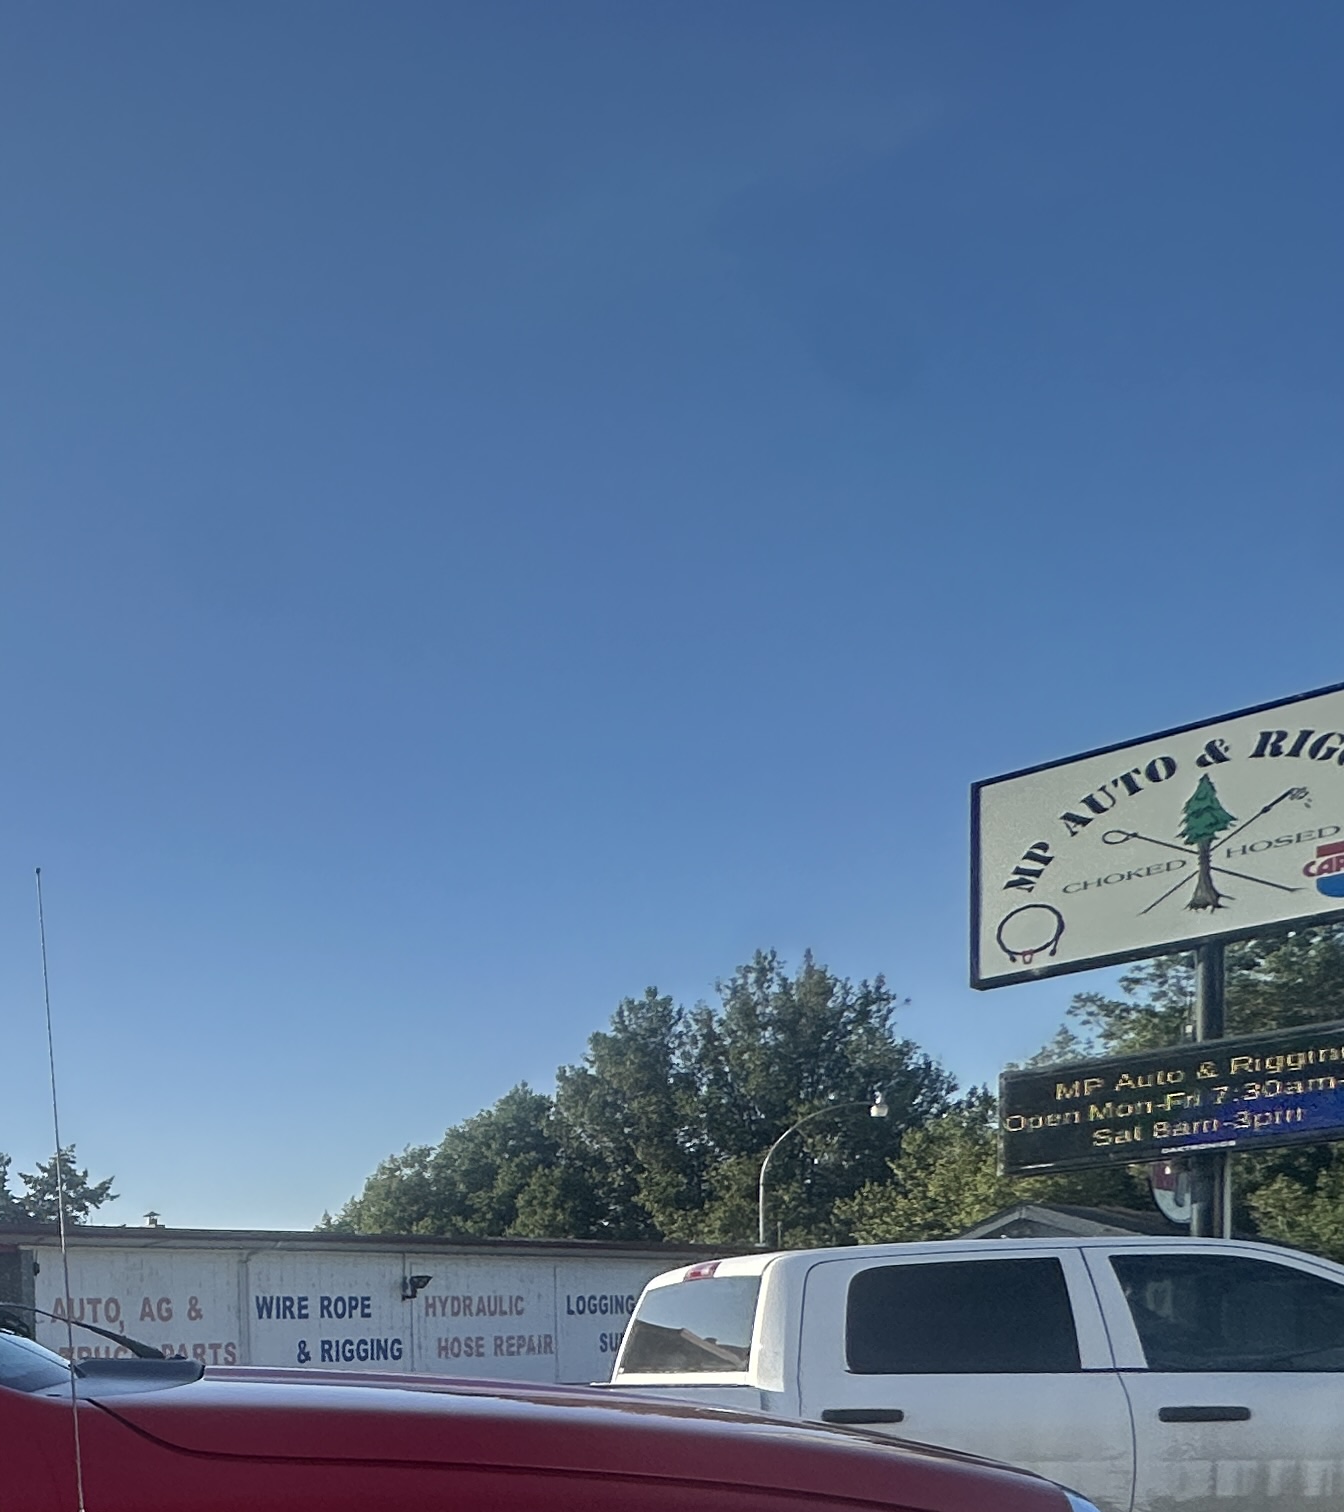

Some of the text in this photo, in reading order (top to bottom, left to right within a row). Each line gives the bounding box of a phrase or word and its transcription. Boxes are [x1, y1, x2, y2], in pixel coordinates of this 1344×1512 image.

[1002, 728, 1344, 893] MP AUTO & RIG
[1062, 825, 1341, 894] CHOKED HOSED
[1055, 1046, 1344, 1101] MP Auto & Riggin
[1003, 1110, 1081, 1133] Open
[1088, 1089, 1201, 1122] Mon-Fri
[1092, 1107, 1305, 1147] Sat 8am-3pm
[50, 1295, 204, 1332] AUTO, AG &
[255, 1295, 372, 1320] WIRE ROPE
[424, 1295, 525, 1318] HYDRAULIC
[566, 1295, 636, 1316] LOGGING
[161, 1342, 237, 1366] PARTS
[297, 1338, 404, 1364] & RIGGING
[437, 1333, 555, 1359] HOSE REPAIR
